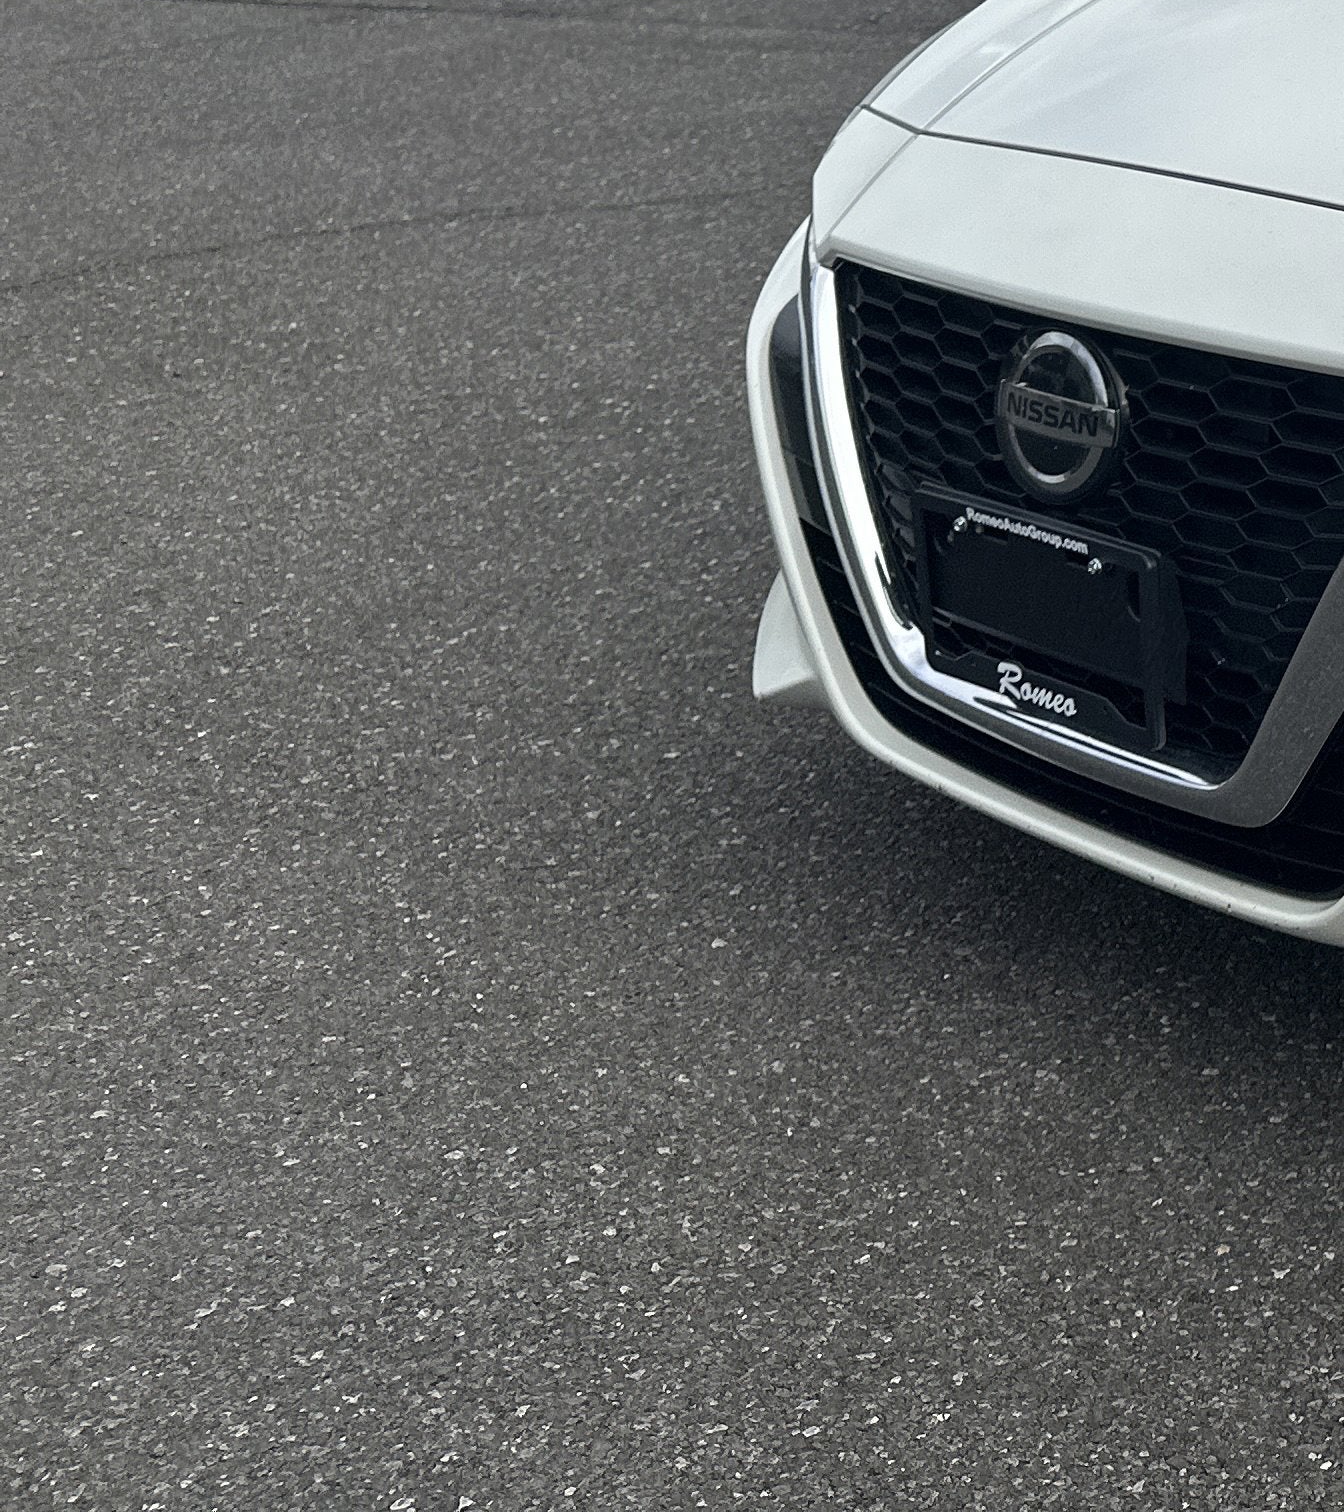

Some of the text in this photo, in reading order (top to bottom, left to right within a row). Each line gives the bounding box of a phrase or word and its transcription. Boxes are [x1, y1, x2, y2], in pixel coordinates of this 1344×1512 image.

[1007, 391, 1099, 437] NISSAN
[965, 507, 1089, 555] RomeoAutoGroup.com
[997, 661, 1077, 717] Romeo
